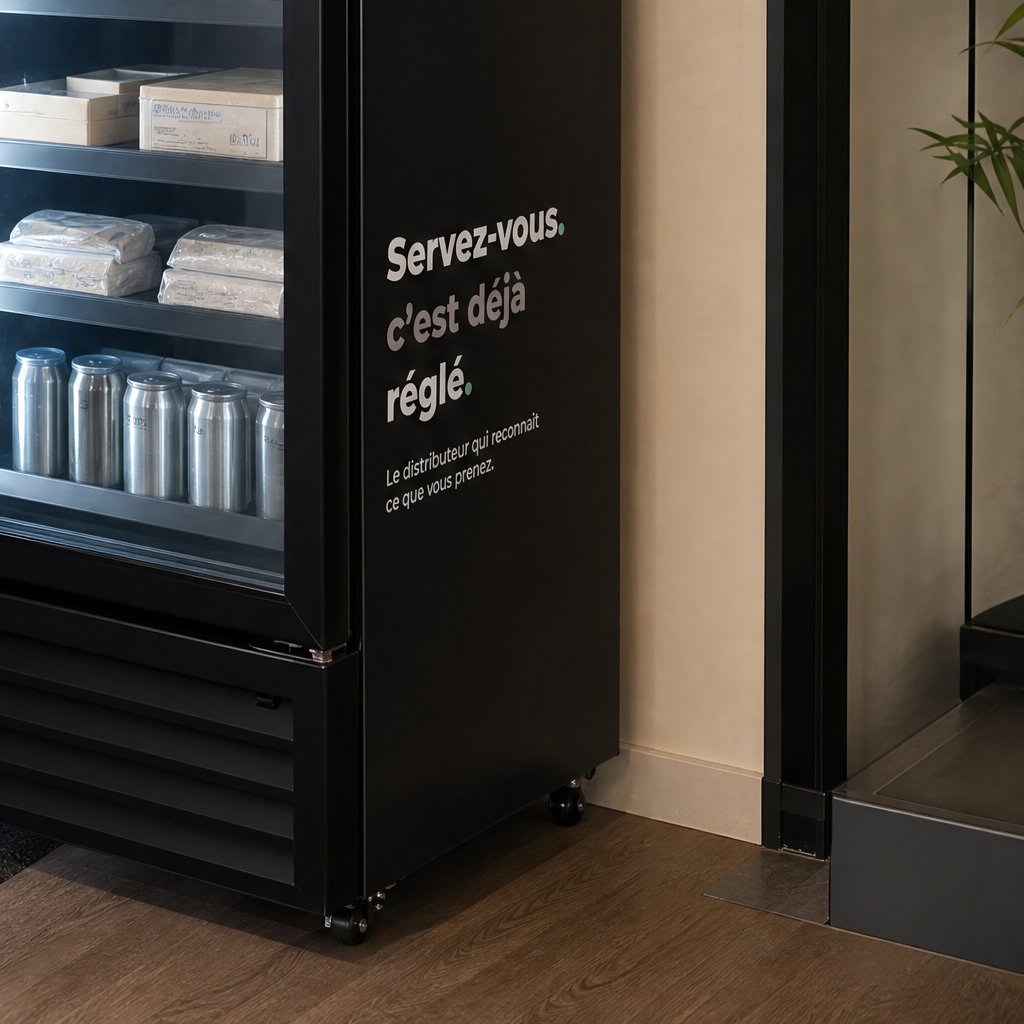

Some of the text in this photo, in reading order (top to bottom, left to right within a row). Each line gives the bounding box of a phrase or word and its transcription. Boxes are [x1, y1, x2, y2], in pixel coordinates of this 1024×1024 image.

[386, 206, 565, 282] Servez-vous.
[386, 271, 526, 352] c’est déjà
[386, 355, 473, 423] réglé.
[385, 459, 495, 514] ce que vous prenez.
[386, 469, 401, 487] Le
[402, 441, 470, 481] distributeur
[471, 430, 489, 457] qui
